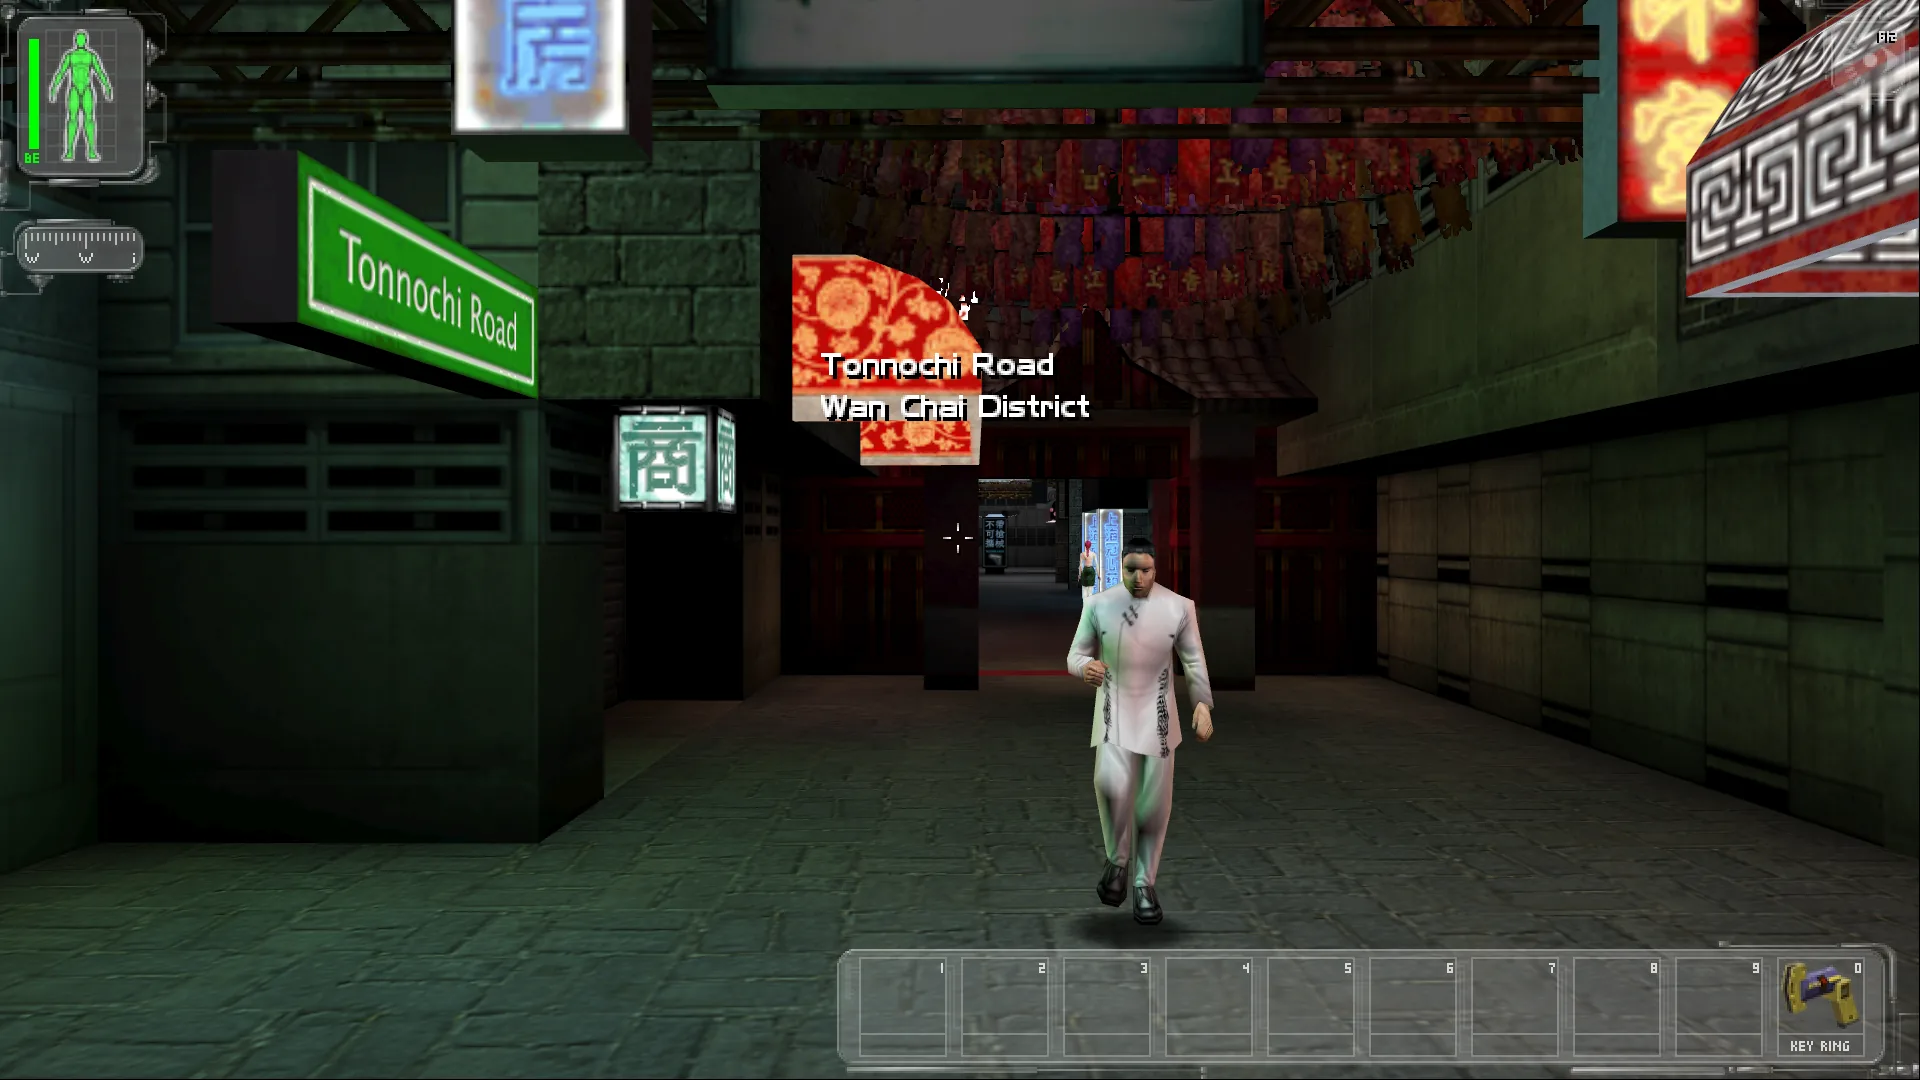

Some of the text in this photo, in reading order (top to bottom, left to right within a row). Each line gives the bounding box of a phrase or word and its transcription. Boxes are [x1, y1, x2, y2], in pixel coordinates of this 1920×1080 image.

[339, 228, 517, 351] Tonnochi Road
[620, 420, 704, 499] 商
